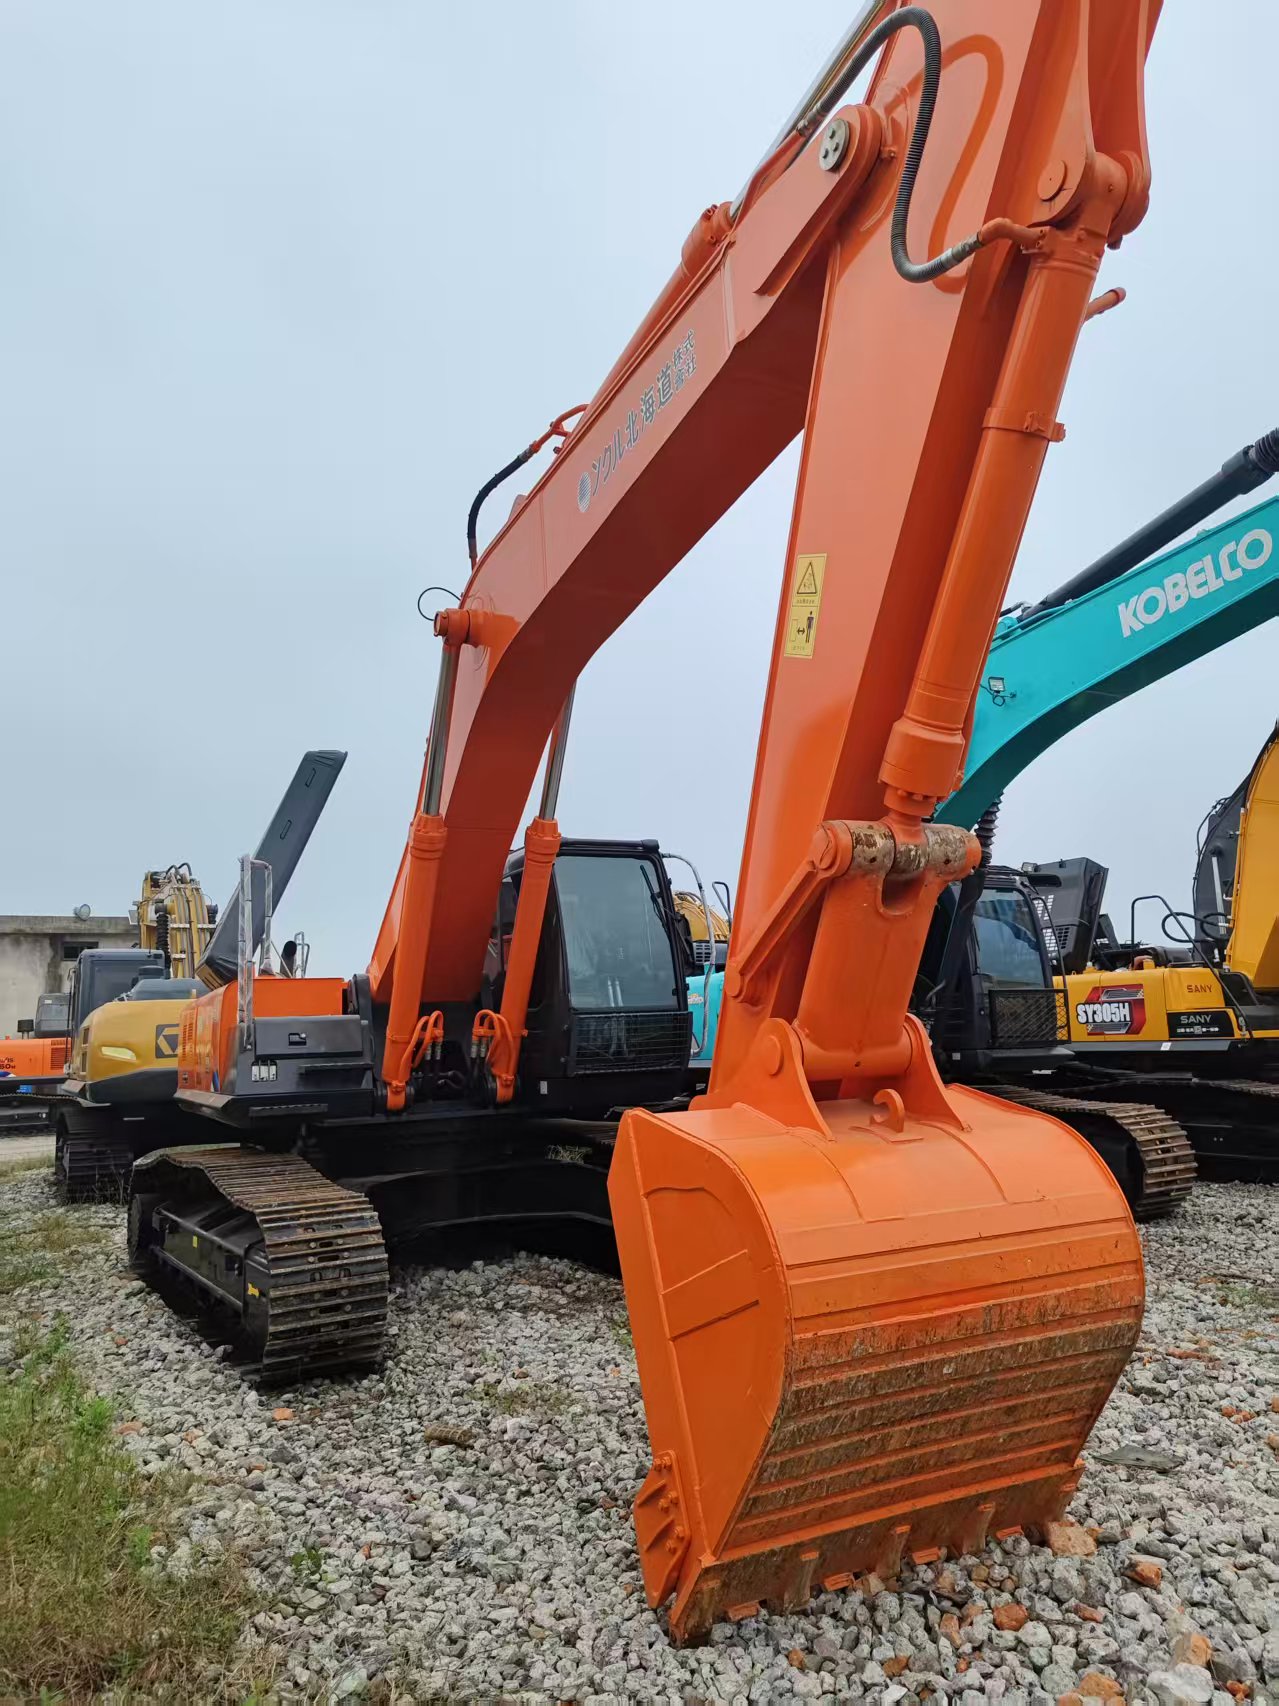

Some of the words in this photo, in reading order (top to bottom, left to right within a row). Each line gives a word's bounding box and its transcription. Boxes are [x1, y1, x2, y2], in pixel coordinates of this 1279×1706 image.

[1117, 528, 1273, 638] KOBELCO
[1186, 984, 1213, 993] SANY
[1076, 1002, 1131, 1024] SY305H
[1180, 1014, 1212, 1024] SANY
